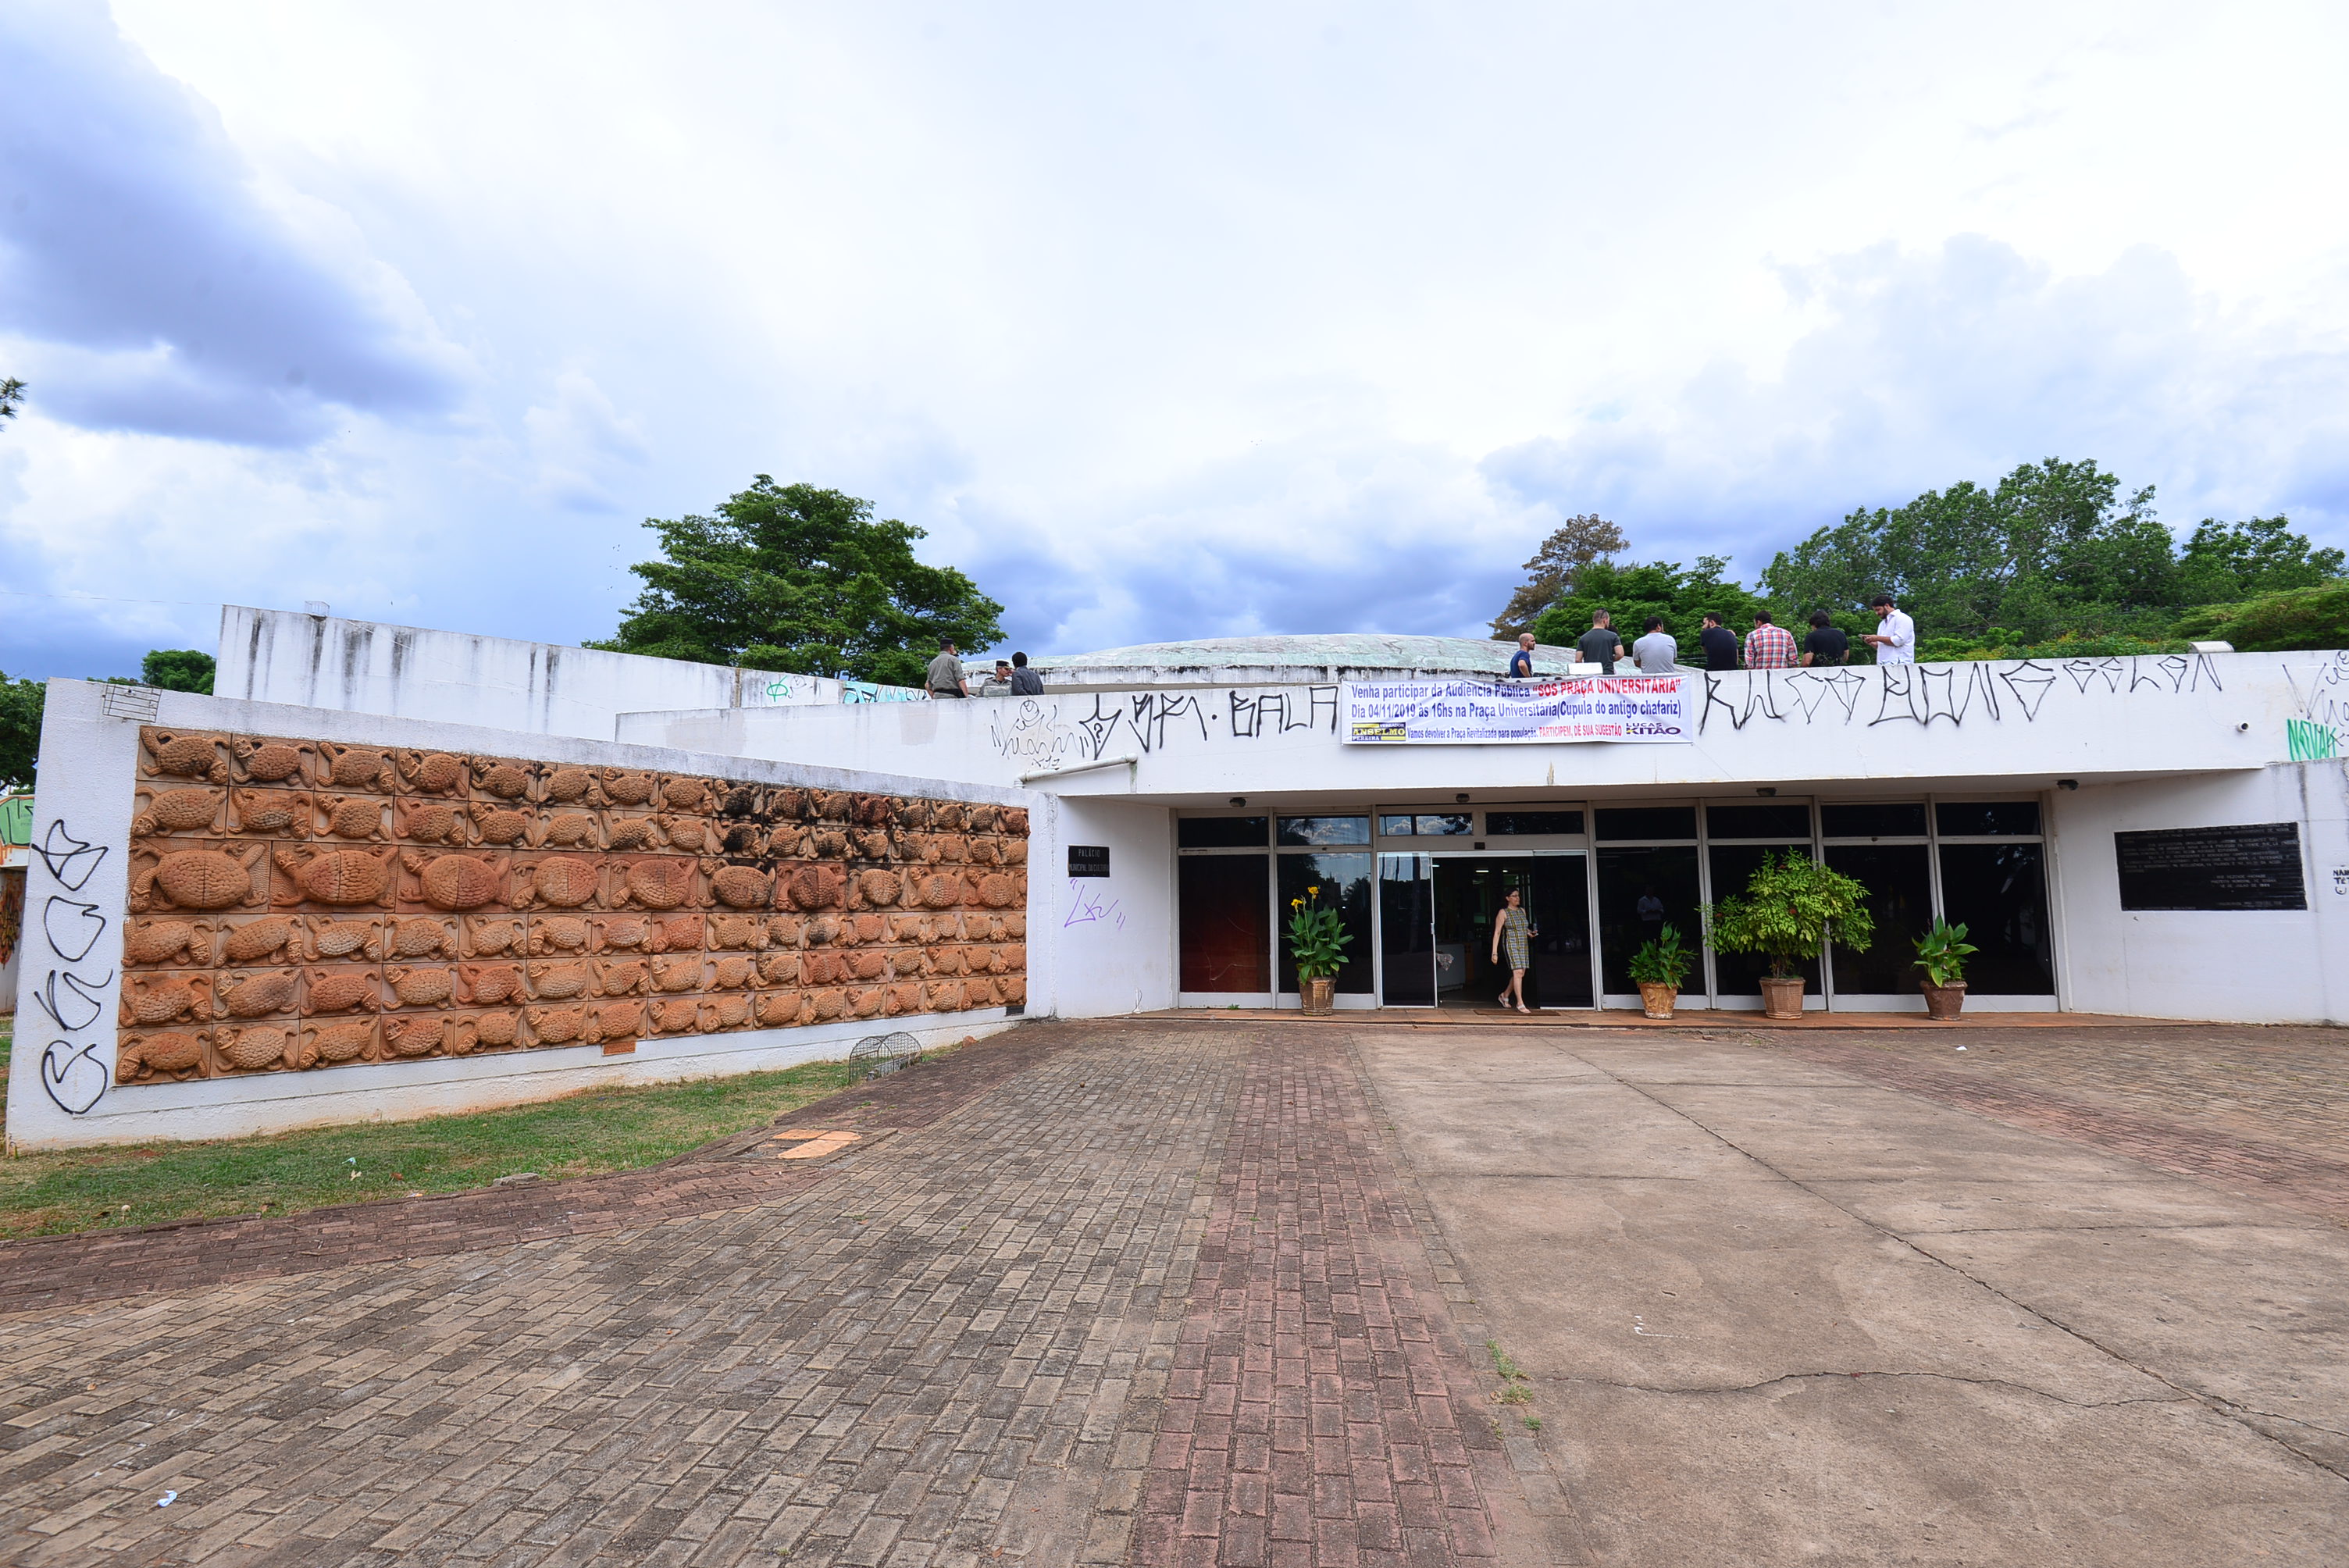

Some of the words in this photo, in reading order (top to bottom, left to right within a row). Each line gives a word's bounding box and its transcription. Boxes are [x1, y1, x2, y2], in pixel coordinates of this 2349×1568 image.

[1352, 684, 1380, 698] Venha
[1383, 683, 1428, 701] participar
[1431, 683, 1442, 697] da
[1445, 682, 1492, 697] Audiência
[1495, 684, 1530, 697] Pública
[1561, 680, 1594, 698] PRAÇA
[1352, 704, 1366, 718] Dia
[1368, 703, 1416, 718] 04/11/2019
[1419, 703, 1429, 717] às
[1432, 702, 1453, 718] 16hs
[1456, 706, 1467, 717] na
[1469, 703, 1495, 721] Praça
[1595, 700, 1606, 715] do
[1609, 700, 1638, 718] antigo
[1640, 700, 1681, 718] chafariz)
[1407, 727, 1424, 739] Vamos
[1425, 727, 1445, 739] devolver
[1446, 729, 1450, 738] a
[1451, 728, 1465, 741] Praça
[1499, 729, 1510, 741] para
[1583, 725, 1594, 736] SUA
[1595, 722, 1622, 736] SUGESTÃO
[1626, 725, 1681, 735] KITÃO
[1078, 848, 1100, 857] PALÁCIO
